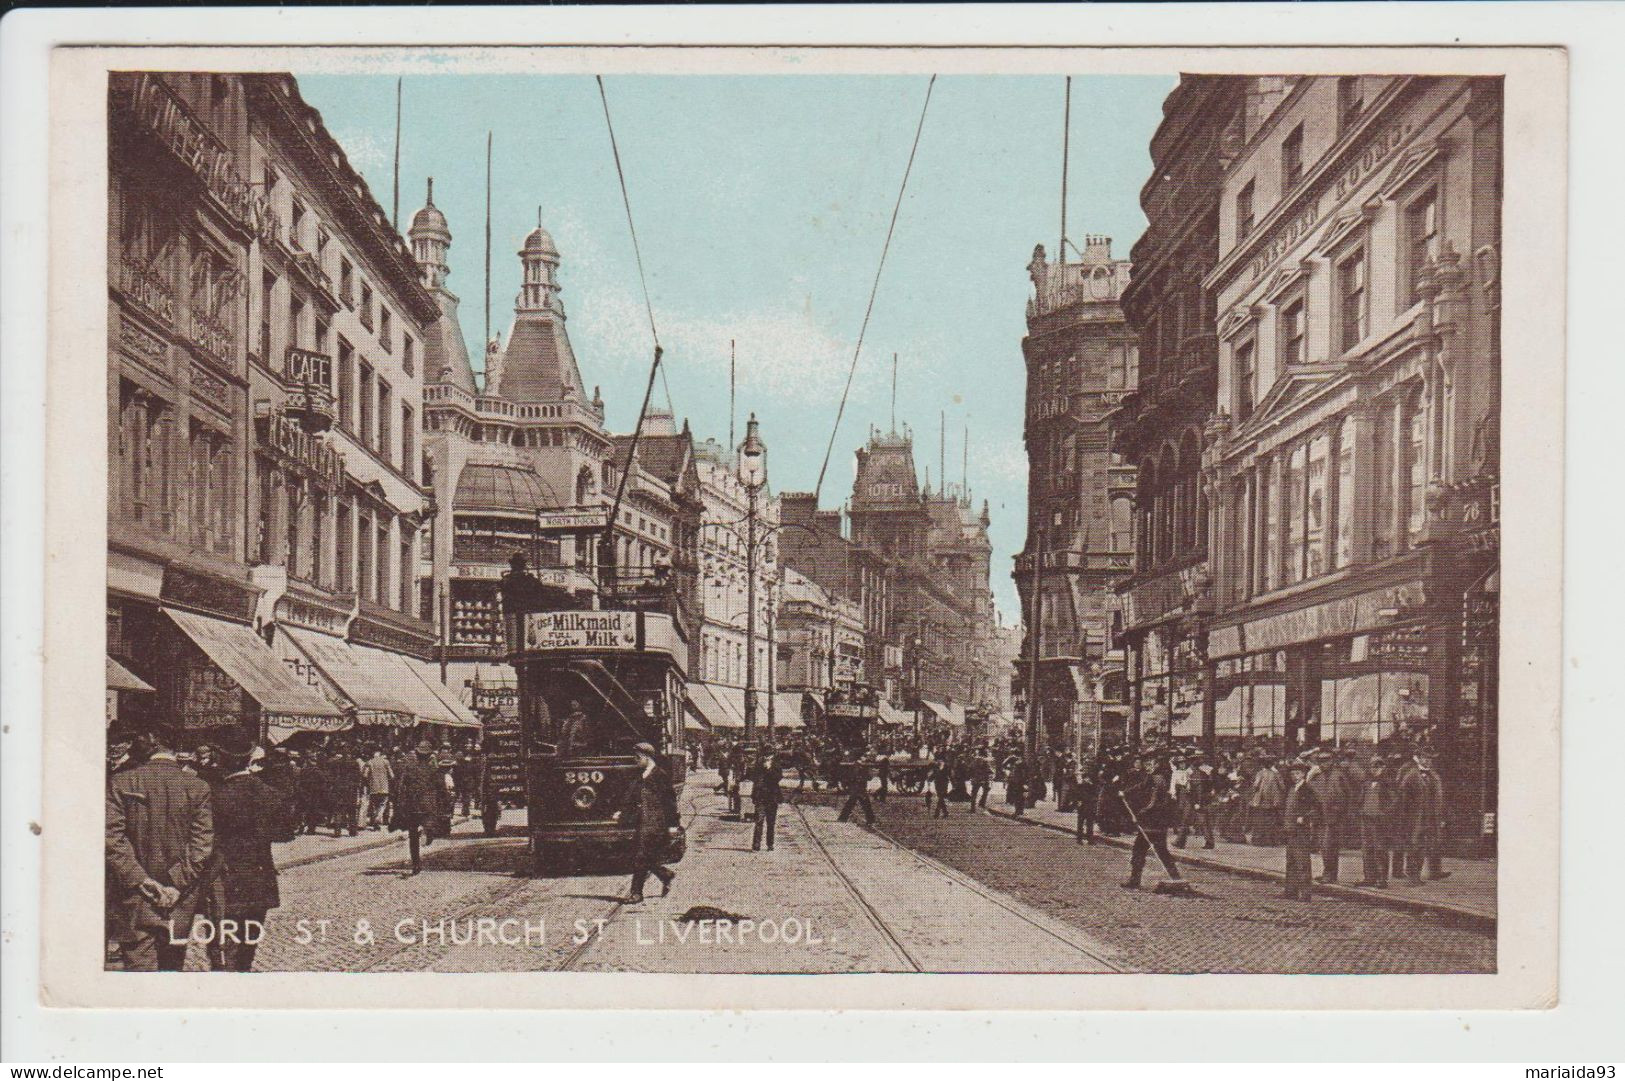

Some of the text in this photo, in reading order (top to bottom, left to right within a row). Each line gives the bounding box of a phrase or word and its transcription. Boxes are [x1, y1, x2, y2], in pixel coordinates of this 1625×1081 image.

[1252, 199, 1320, 281] DRESDEN
[546, 517, 571, 526] NORTH
[553, 614, 621, 632] Milkmaid
[539, 631, 619, 648] CREAM Milk
